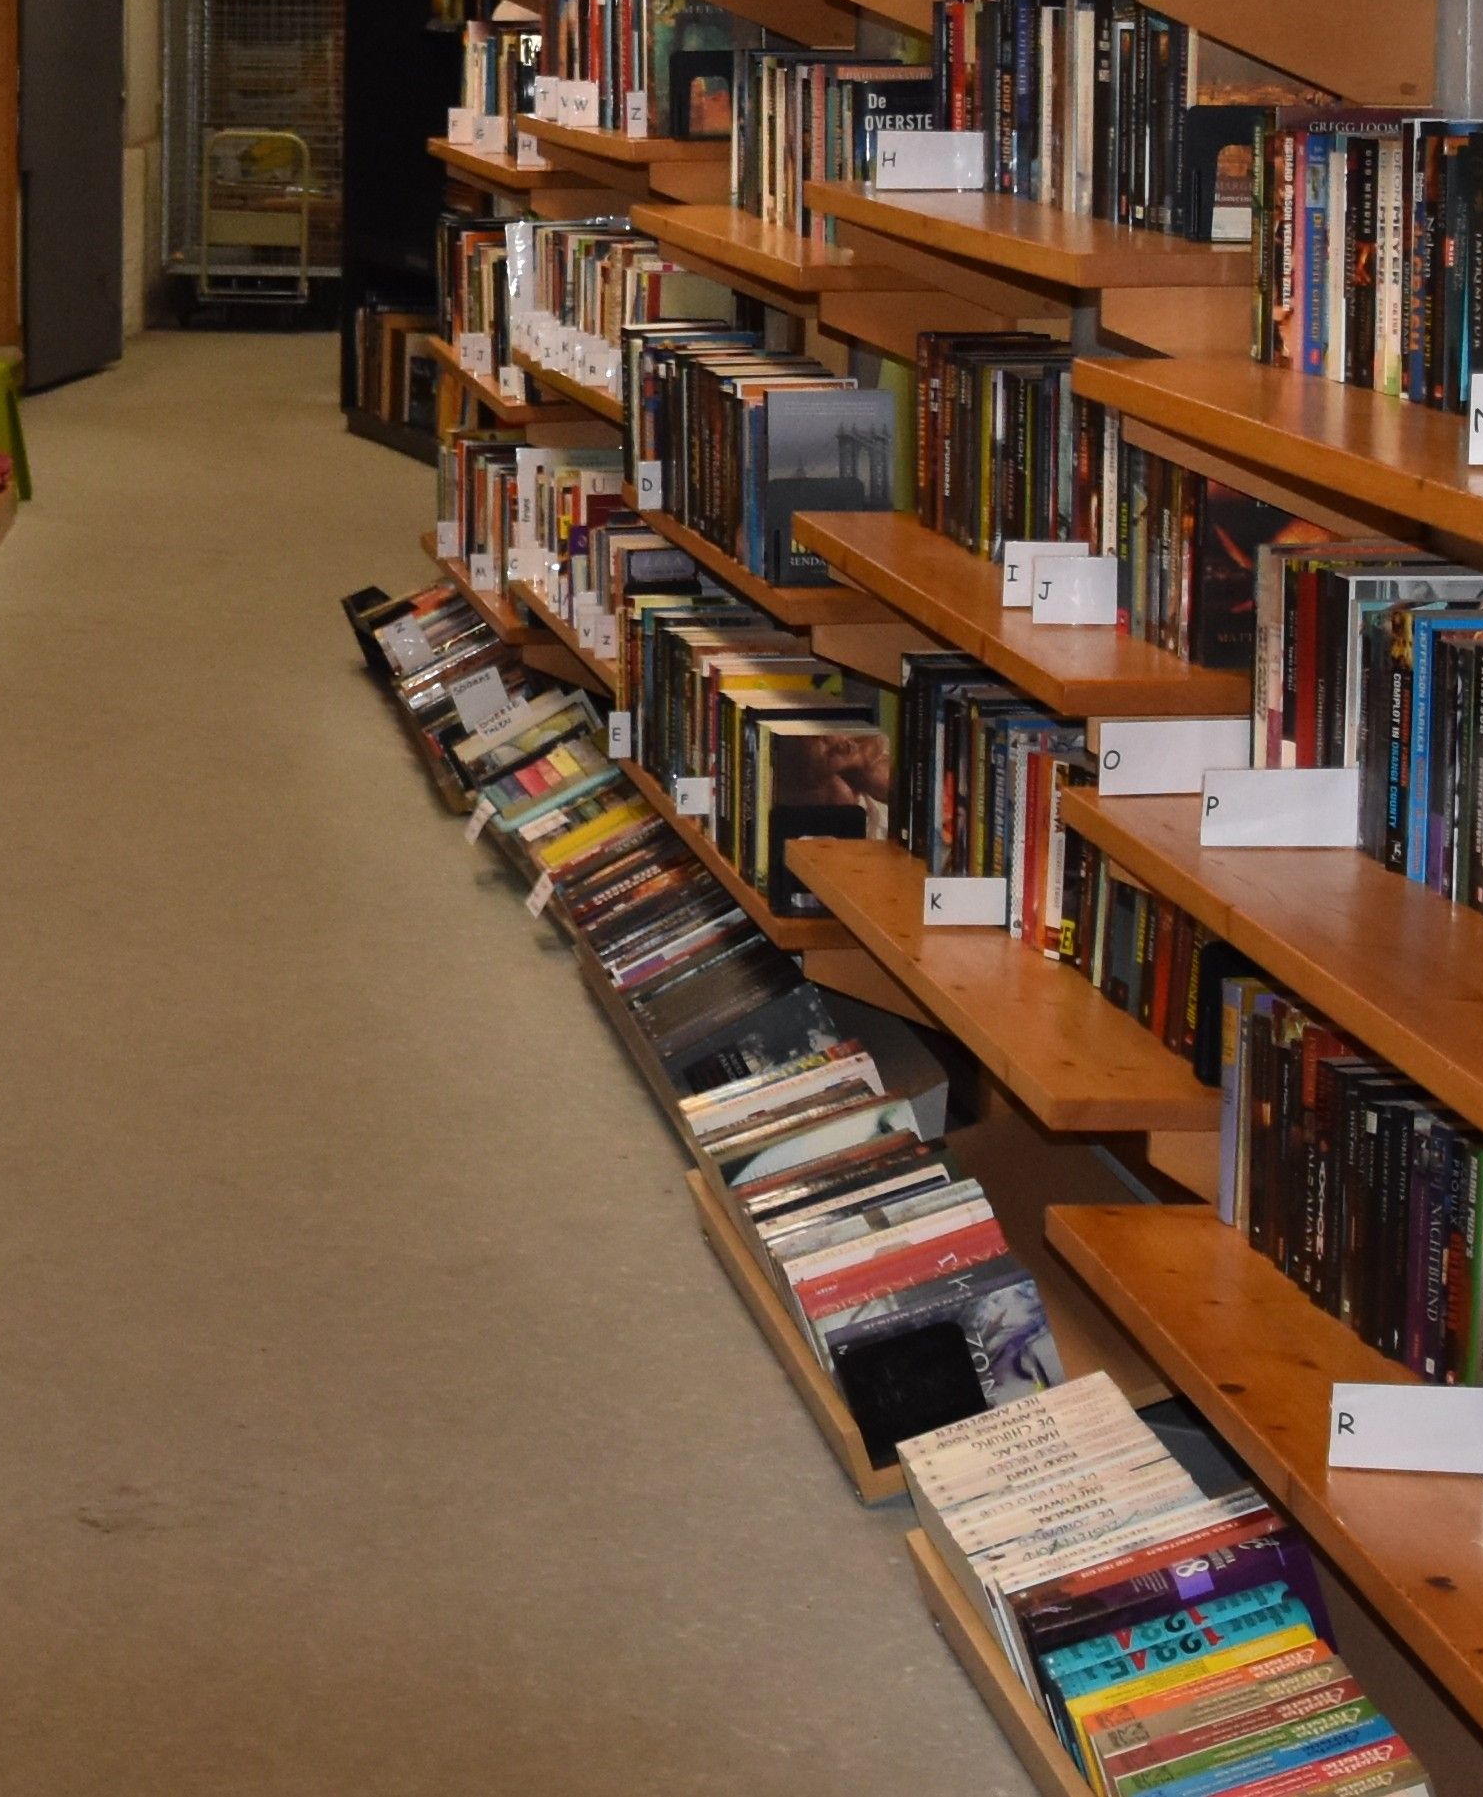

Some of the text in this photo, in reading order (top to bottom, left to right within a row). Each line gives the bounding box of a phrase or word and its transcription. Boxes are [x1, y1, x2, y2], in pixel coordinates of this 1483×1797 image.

[573, 97, 590, 113] W
[868, 93, 887, 109] De
[630, 106, 642, 121] Z
[881, 150, 897, 169] H
[641, 475, 654, 493] D
[1006, 563, 1019, 585] I
[1037, 580, 1054, 602] J
[1392, 672, 1401, 725] COMPLOT
[611, 727, 622, 742] E
[1392, 729, 1399, 740] IN
[1102, 748, 1121, 771] O
[1205, 795, 1220, 817] P
[929, 891, 943, 911] K
[1336, 1411, 1356, 1435] R
